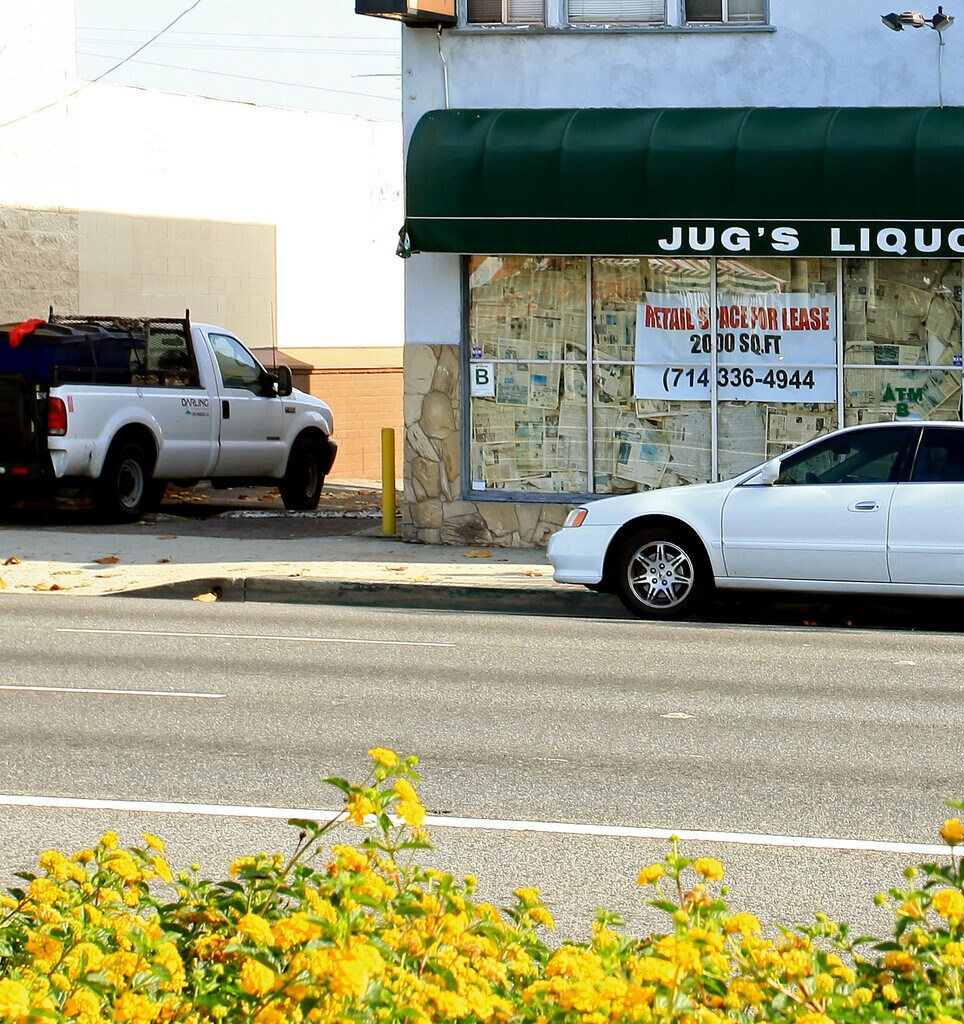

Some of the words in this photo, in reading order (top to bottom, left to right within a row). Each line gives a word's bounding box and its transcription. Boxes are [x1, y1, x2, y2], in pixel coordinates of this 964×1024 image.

[658, 227, 800, 251] JUG'S
[645, 305, 695, 331] RETAIL
[751, 306, 778, 331] FOR
[782, 307, 830, 331] LEASE
[475, 368, 489, 385] B
[882, 382, 923, 402] ATM
